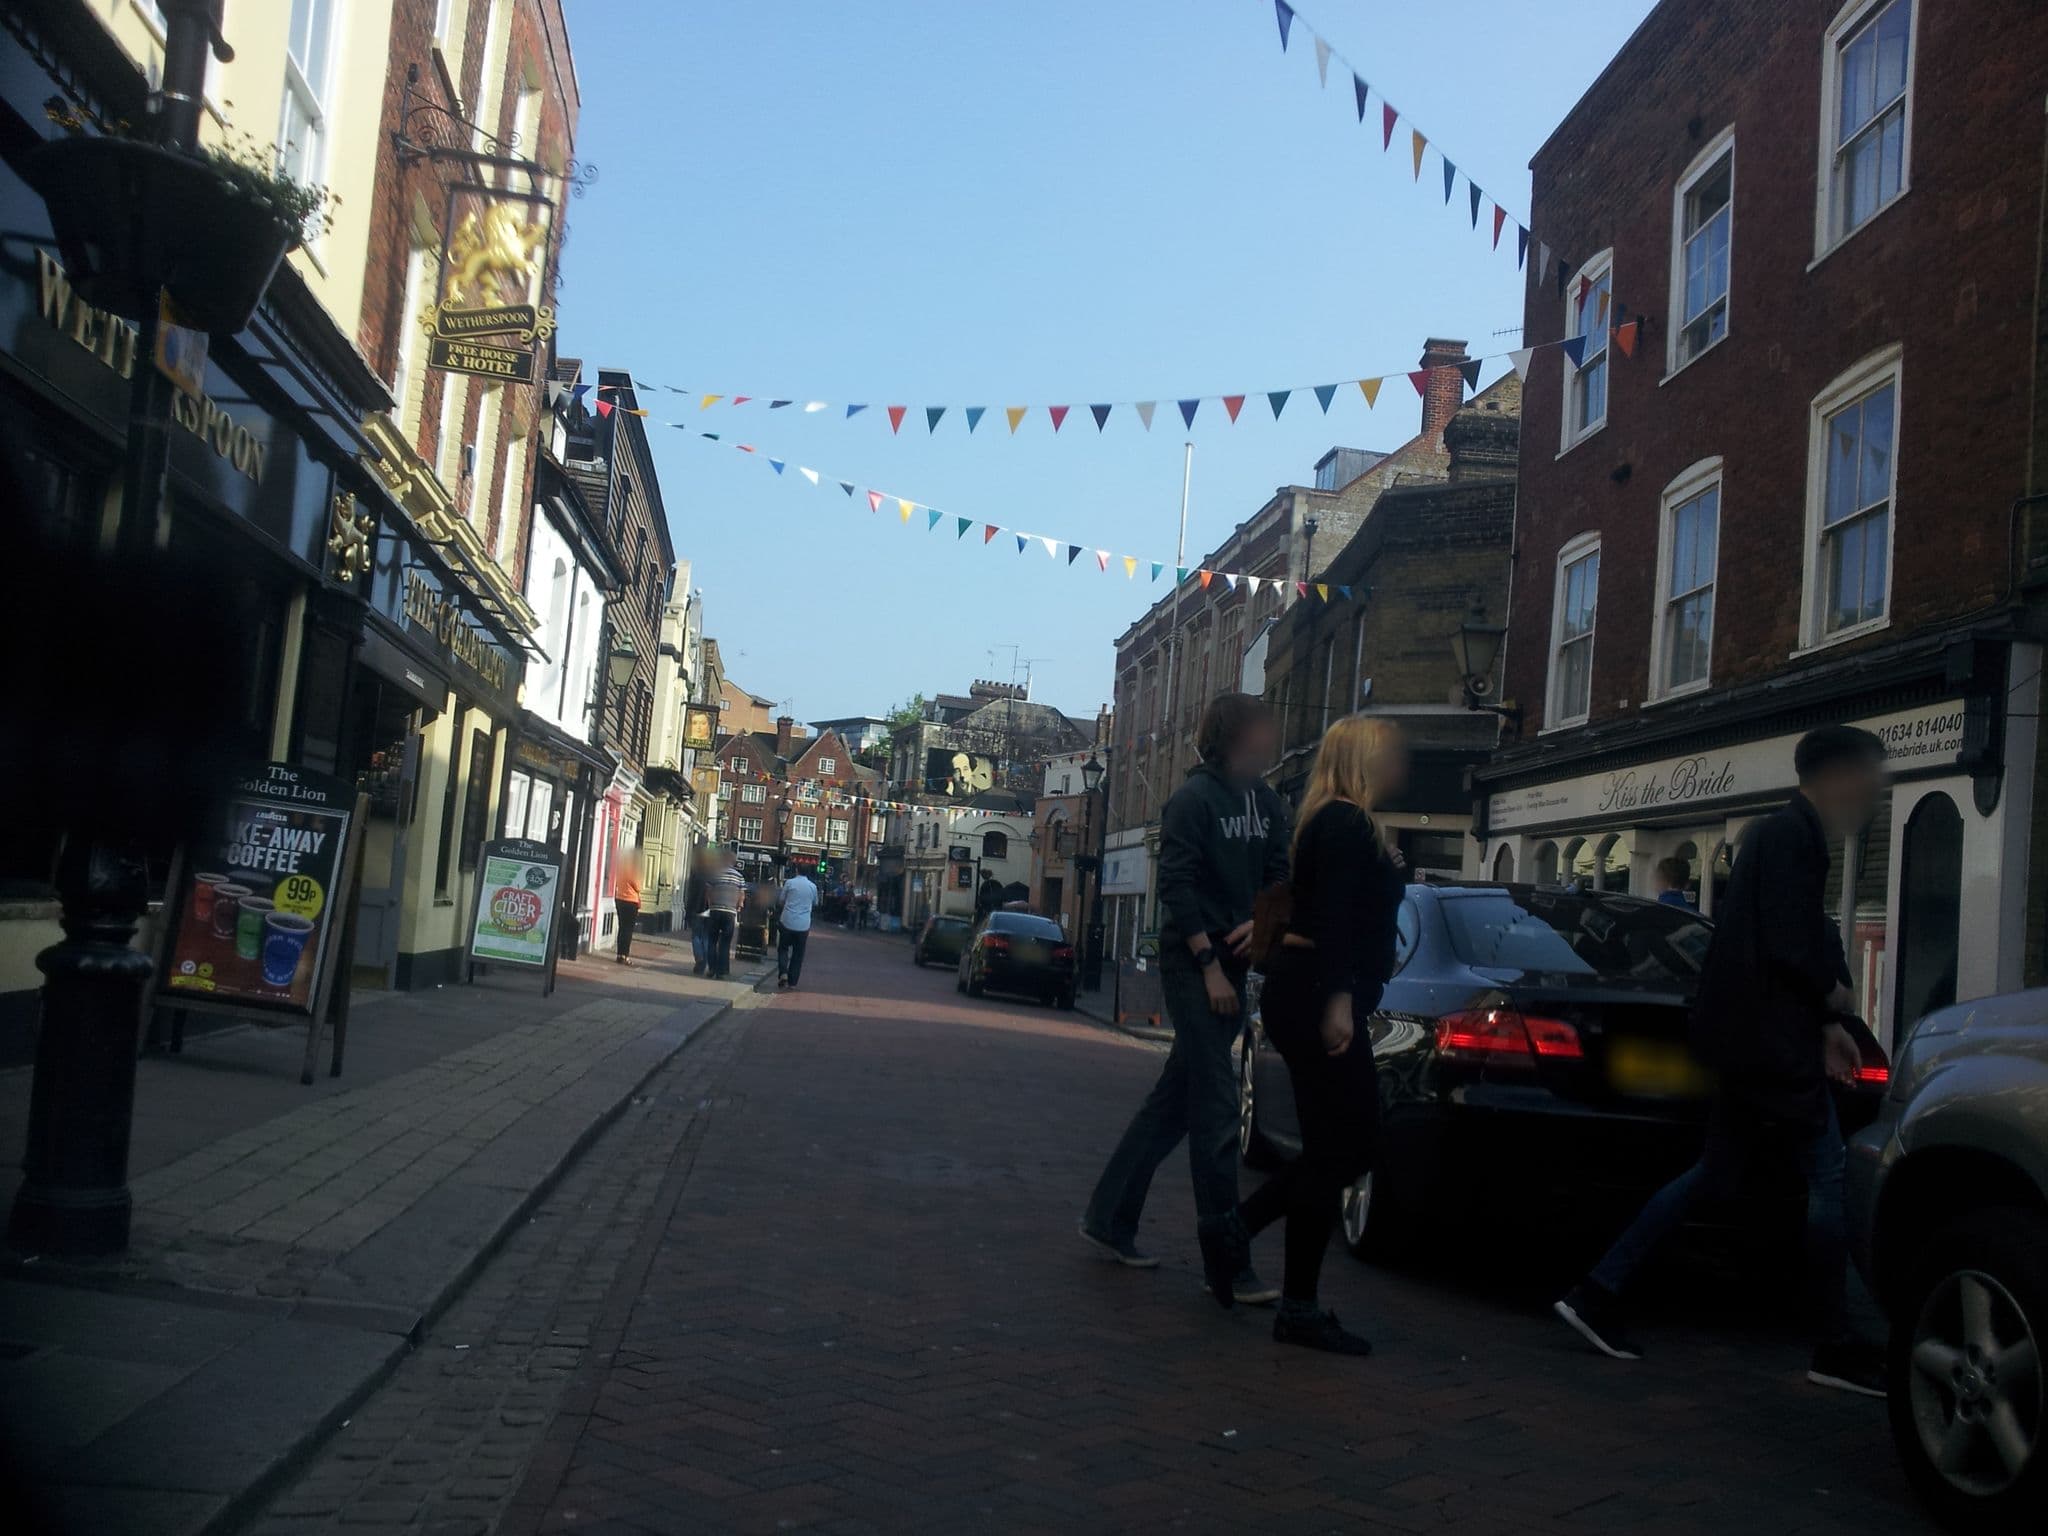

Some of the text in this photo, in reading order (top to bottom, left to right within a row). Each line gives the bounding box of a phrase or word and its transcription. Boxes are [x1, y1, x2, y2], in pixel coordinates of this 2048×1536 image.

[444, 312, 530, 330] WETHERSPOON
[446, 353, 516, 375] & HOTEL
[448, 343, 519, 363] FREE HOUSE
[1878, 712, 1963, 743] 01634 814040
[267, 766, 298, 782] The
[1598, 756, 1735, 812] Kiss the Bride
[240, 779, 327, 802] olden Lion
[226, 842, 302, 874] COFFEE
[286, 877, 317, 903] 99p
[501, 890, 535, 906] CRAFT
[494, 899, 537, 919] CIDER
